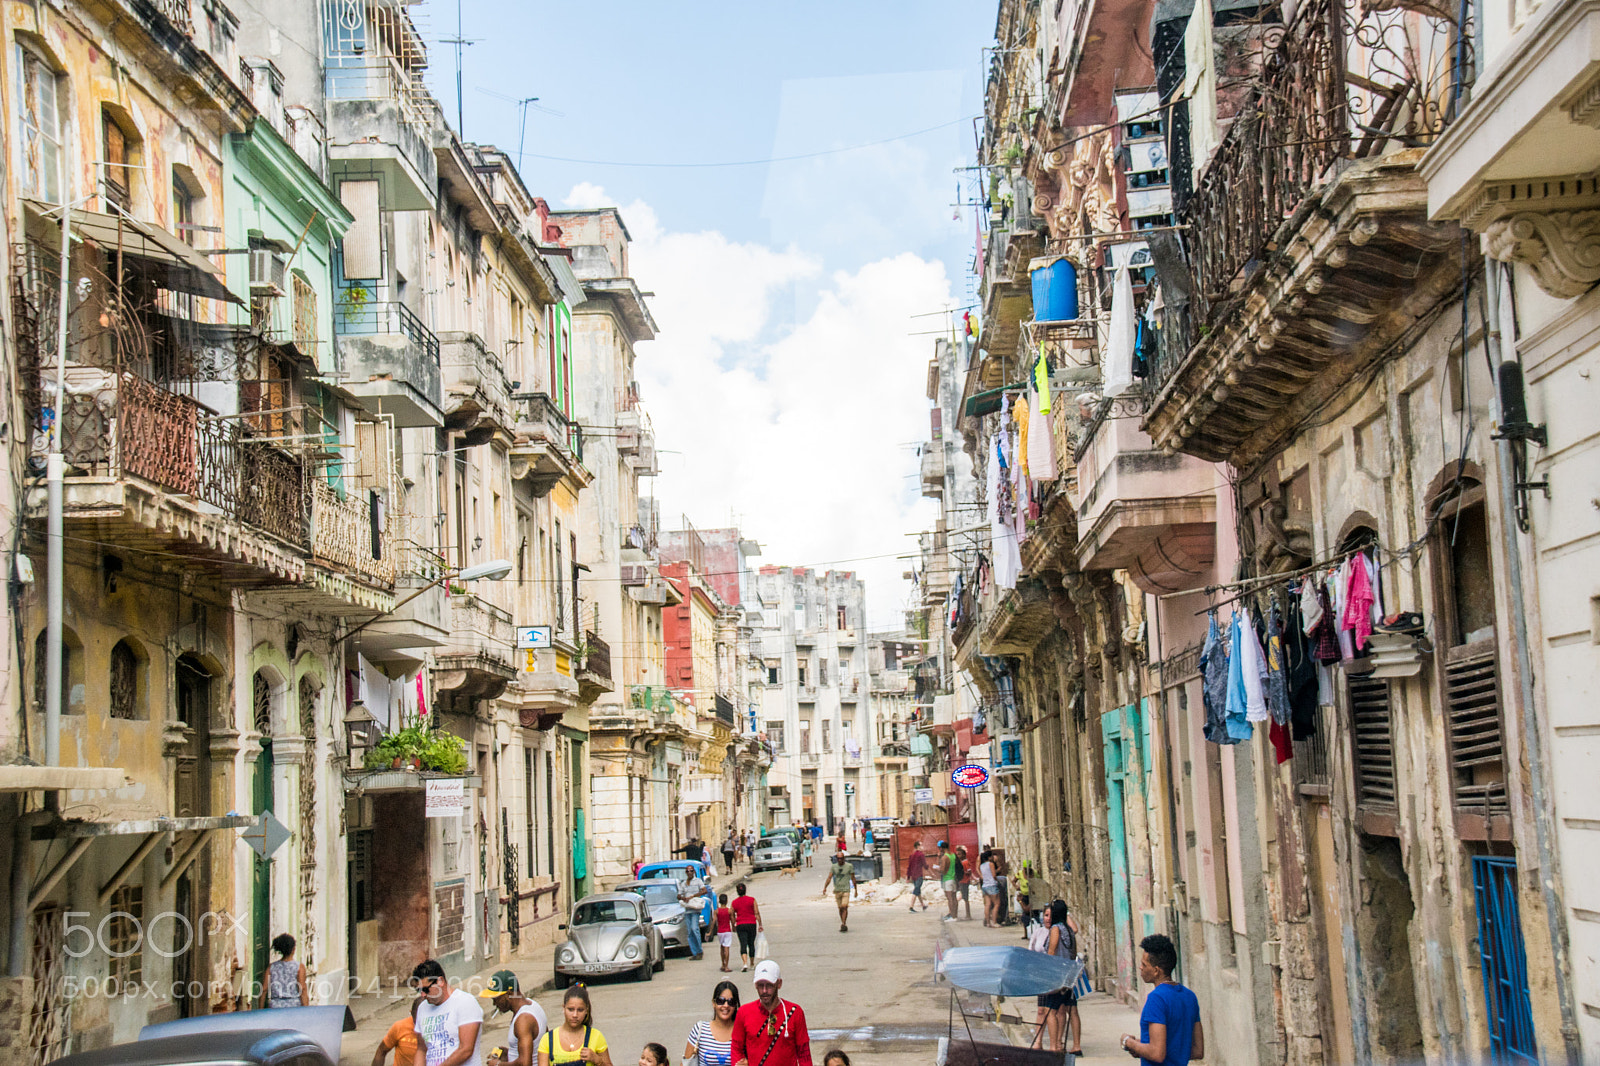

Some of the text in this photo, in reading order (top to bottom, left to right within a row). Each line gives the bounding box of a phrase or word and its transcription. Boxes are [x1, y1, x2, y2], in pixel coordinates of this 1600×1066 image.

[422, 1016, 434, 1025] LIFE
[424, 1022, 444, 1033] ABOUT
[426, 1048, 446, 1058] BOUT
